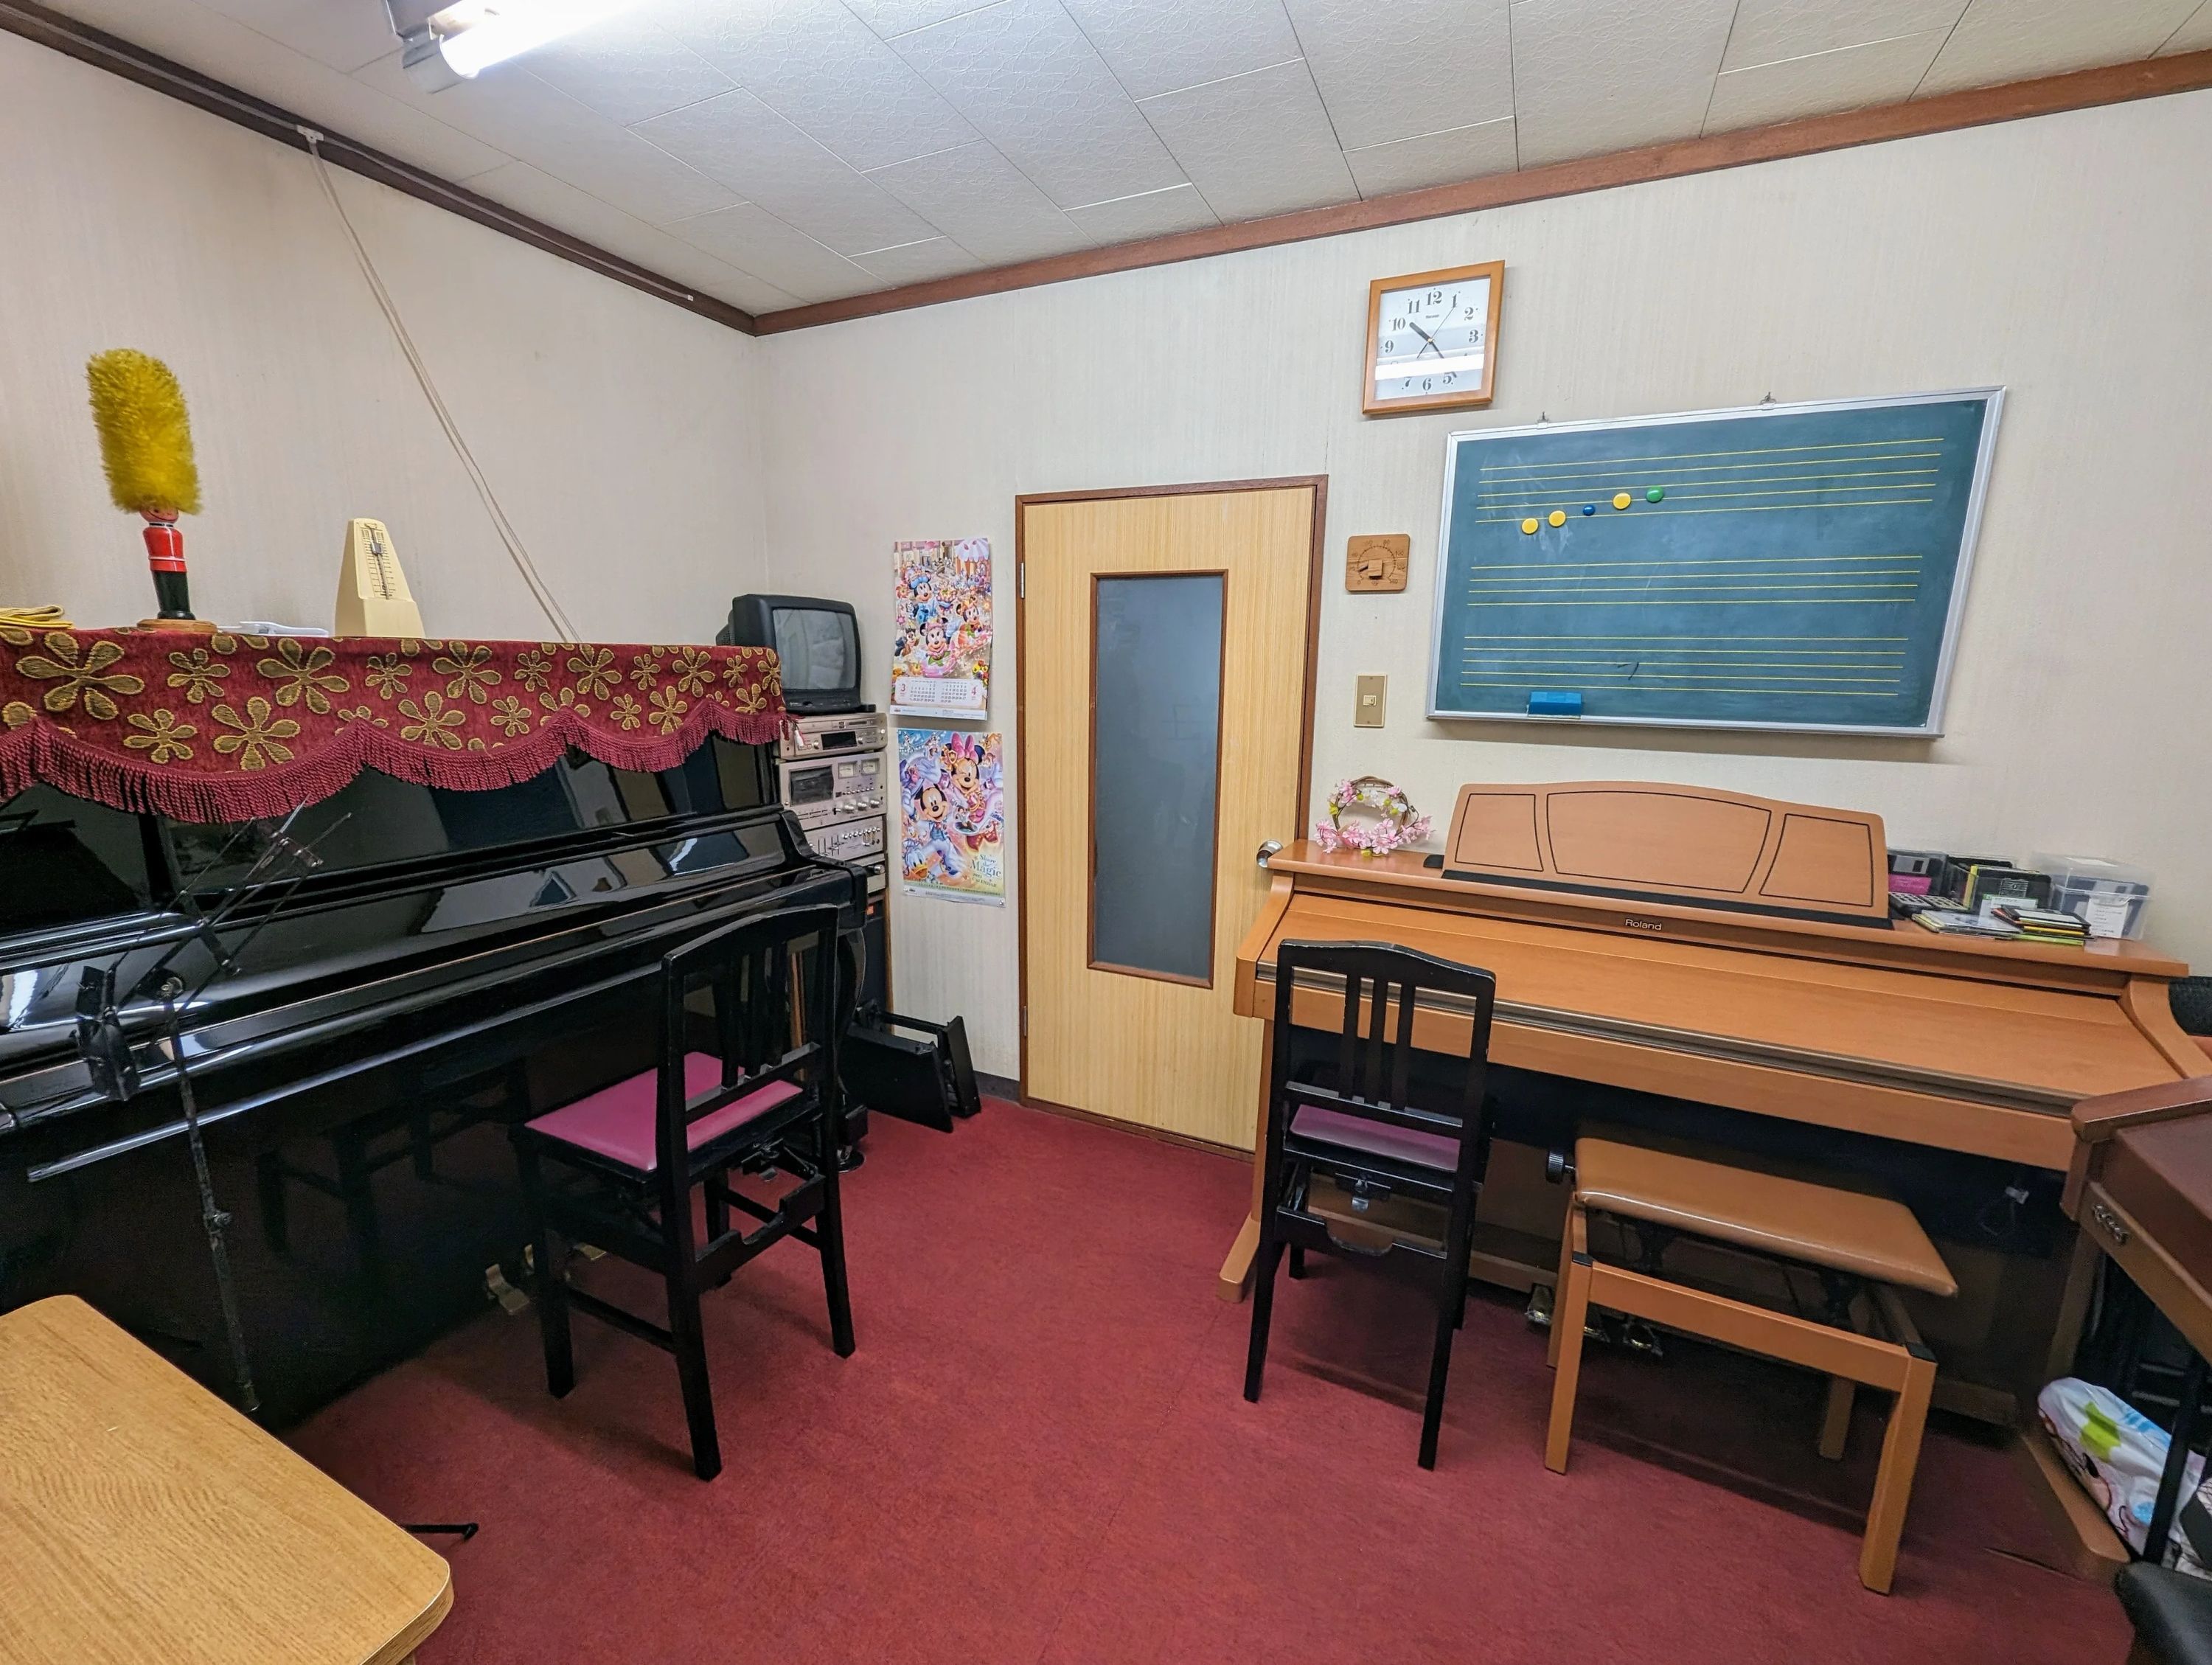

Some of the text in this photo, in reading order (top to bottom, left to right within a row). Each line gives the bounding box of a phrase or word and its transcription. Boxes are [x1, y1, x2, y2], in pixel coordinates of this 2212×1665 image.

[1426, 291, 1442, 305] 12
[1451, 293, 1458, 308] 1
[1407, 299, 1421, 314] 11
[1464, 307, 1474, 321] 2
[1391, 317, 1406, 331] 10
[1468, 330, 1479, 344] 3
[1385, 340, 1394, 353] 9
[1403, 377, 1412, 388] 7
[1422, 378, 1432, 391] 6
[1443, 372, 1452, 384] 5
[901, 684, 905, 692] 3
[972, 686, 977, 695] 4
[970, 859, 1001, 877] Magic
[1625, 919, 1662, 931] Roland
